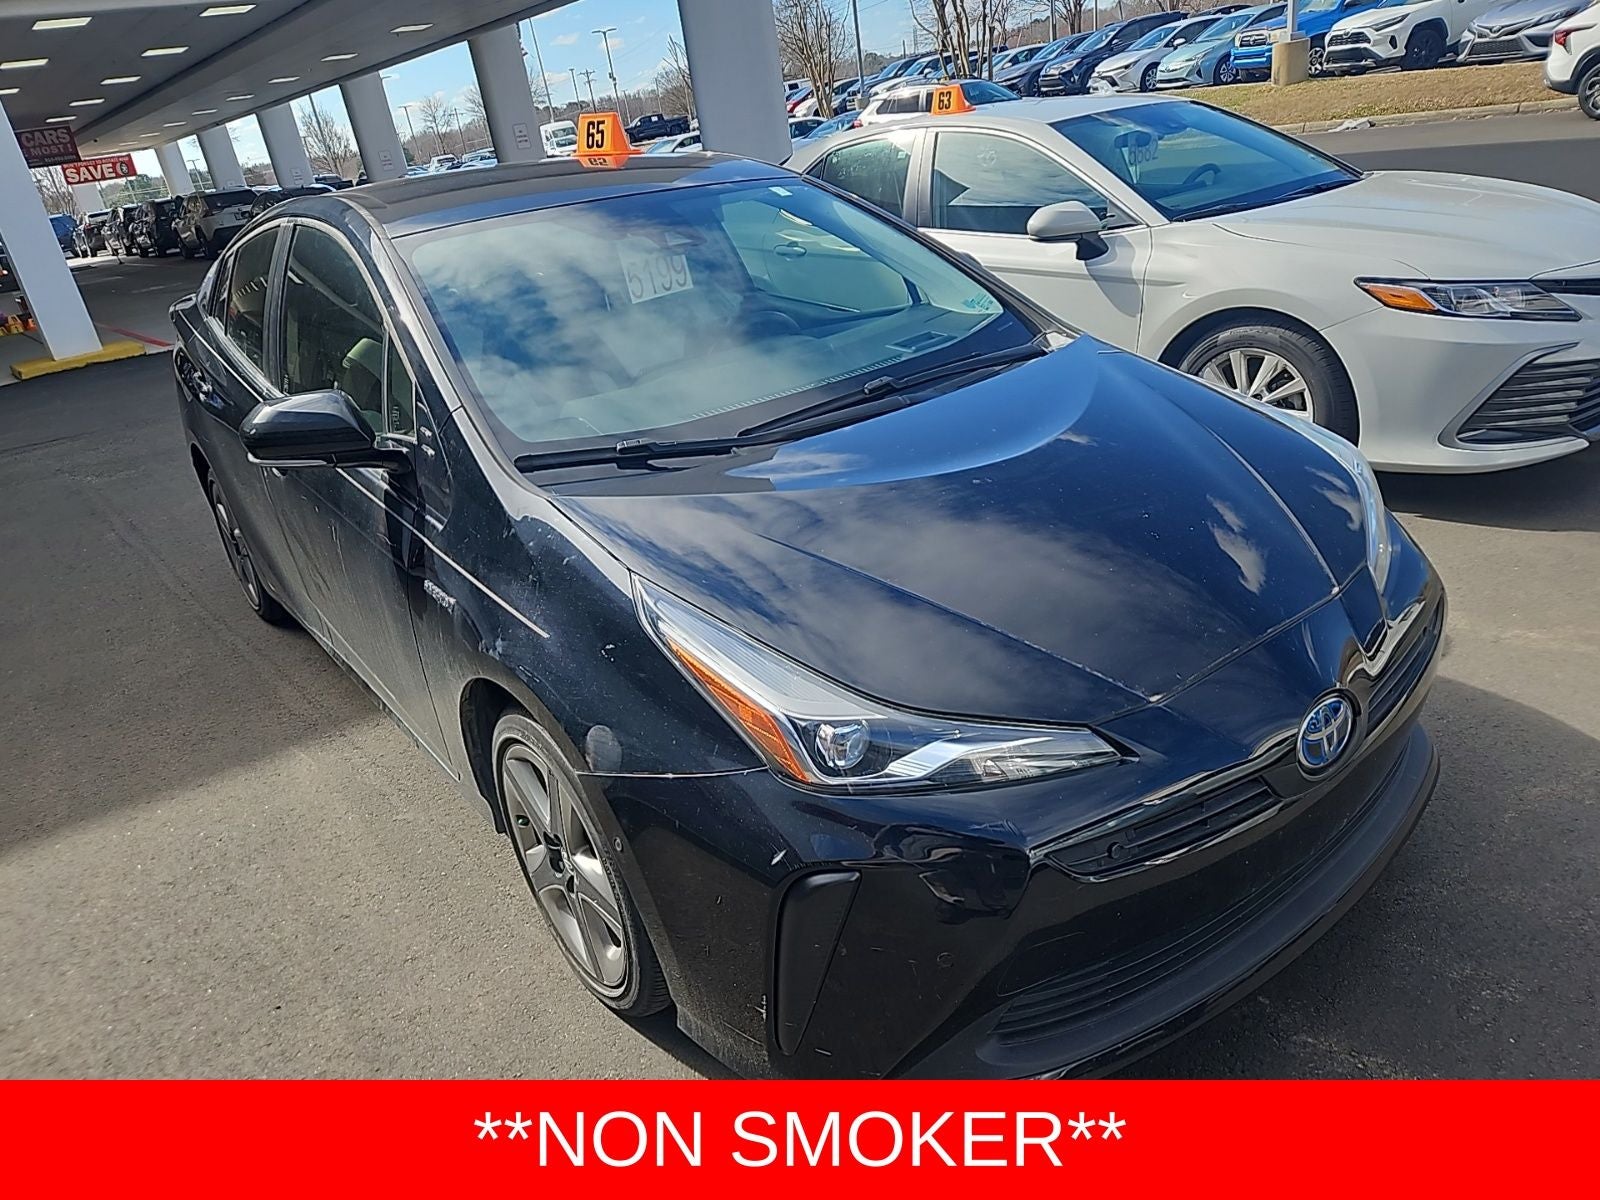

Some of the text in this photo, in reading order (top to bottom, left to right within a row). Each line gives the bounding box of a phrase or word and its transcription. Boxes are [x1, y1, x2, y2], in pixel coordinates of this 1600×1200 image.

[938, 91, 952, 110] 63
[21, 128, 71, 147] CARS
[586, 120, 606, 149] 65
[65, 164, 116, 183] SAVE
